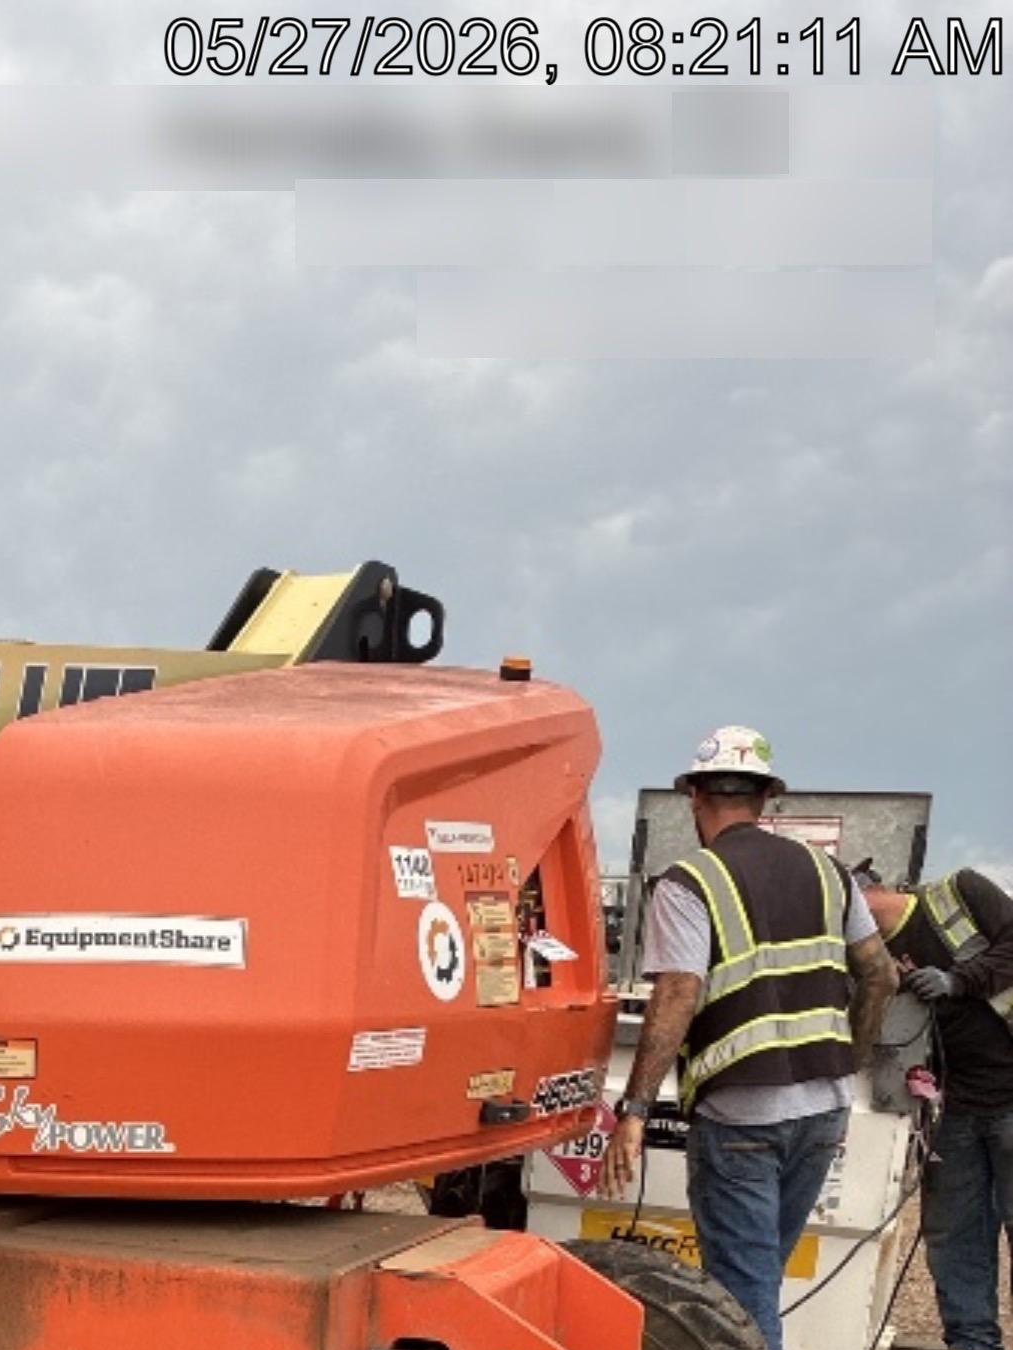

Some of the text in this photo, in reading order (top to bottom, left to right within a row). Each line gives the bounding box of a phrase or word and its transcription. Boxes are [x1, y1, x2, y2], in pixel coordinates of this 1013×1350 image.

[25, 927, 233, 951] EquipmentShare
[561, 1133, 612, 1159] 199
[579, 1164, 592, 1183] 3
